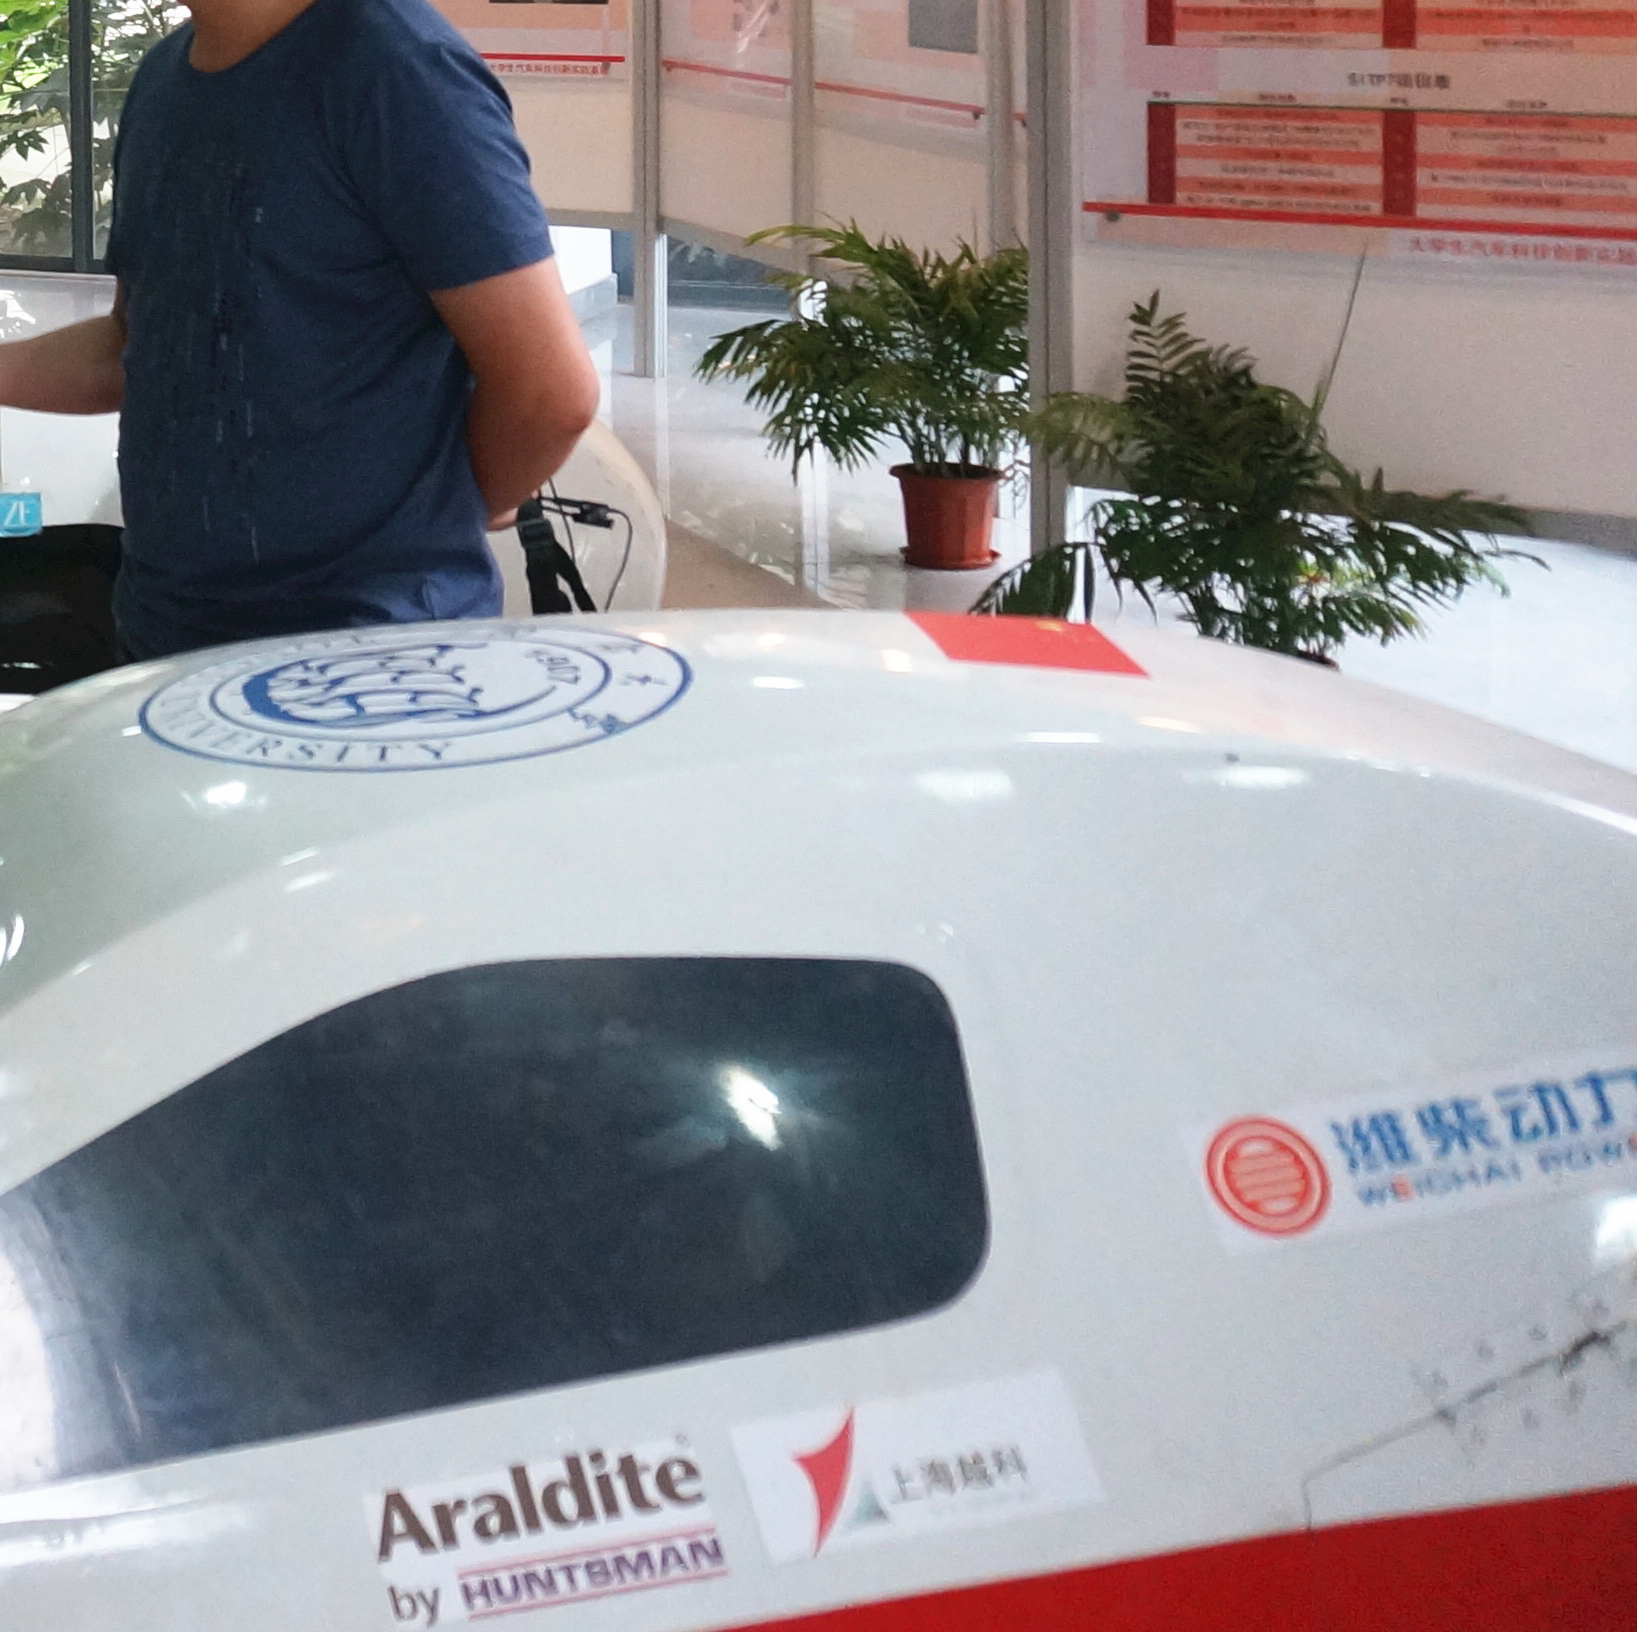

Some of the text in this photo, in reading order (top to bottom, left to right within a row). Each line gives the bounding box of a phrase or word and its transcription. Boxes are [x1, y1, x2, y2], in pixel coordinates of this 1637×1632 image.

[377, 1447, 706, 1564] Araldite
[387, 1536, 725, 1627] by HUNTSMAN
